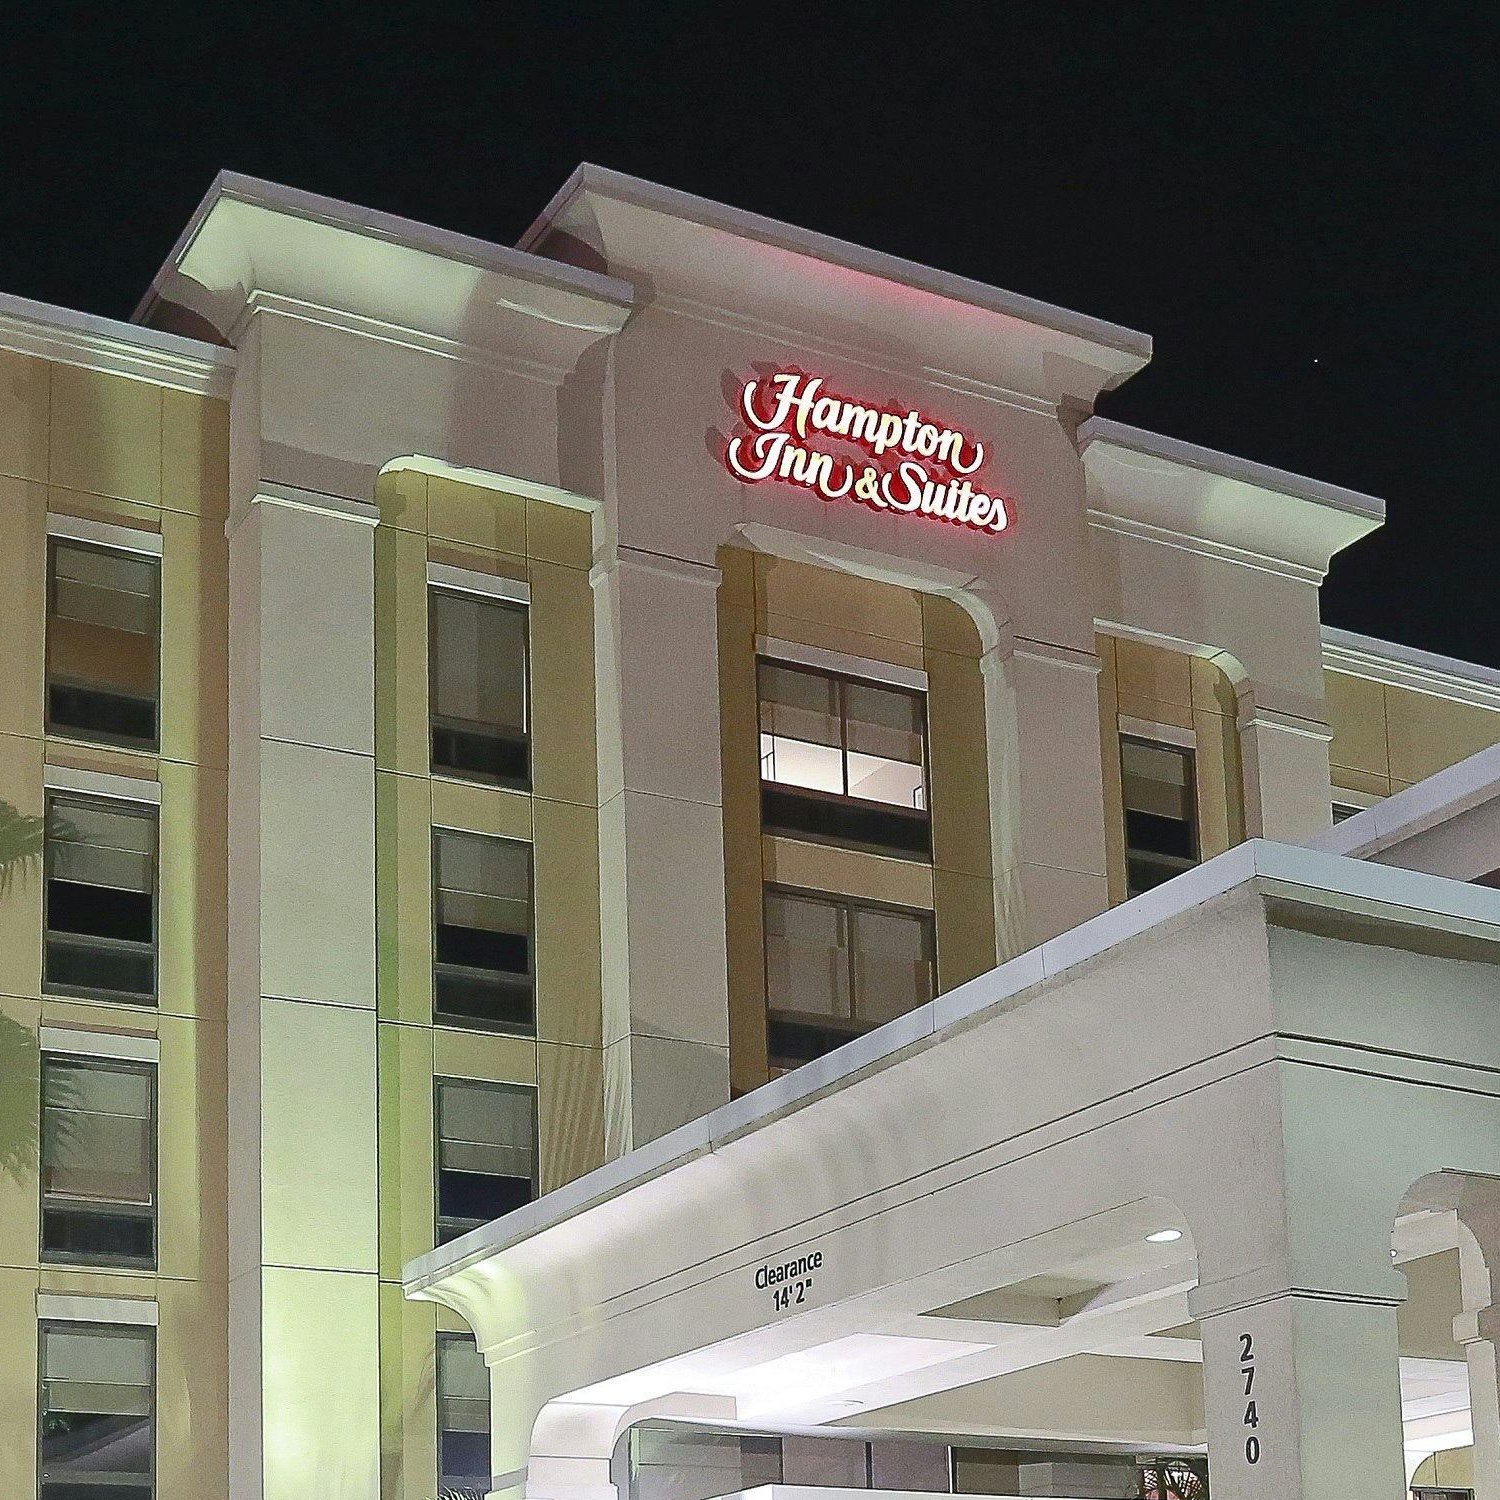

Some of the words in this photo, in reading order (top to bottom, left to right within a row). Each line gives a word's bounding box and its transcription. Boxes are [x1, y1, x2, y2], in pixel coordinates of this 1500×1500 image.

[743, 373, 984, 474] Hampton
[728, 431, 853, 497] Inn
[855, 467, 888, 507] &
[882, 461, 1009, 531] Suites
[755, 1251, 822, 1289] Clearance
[1239, 1333, 1260, 1465] 2740
